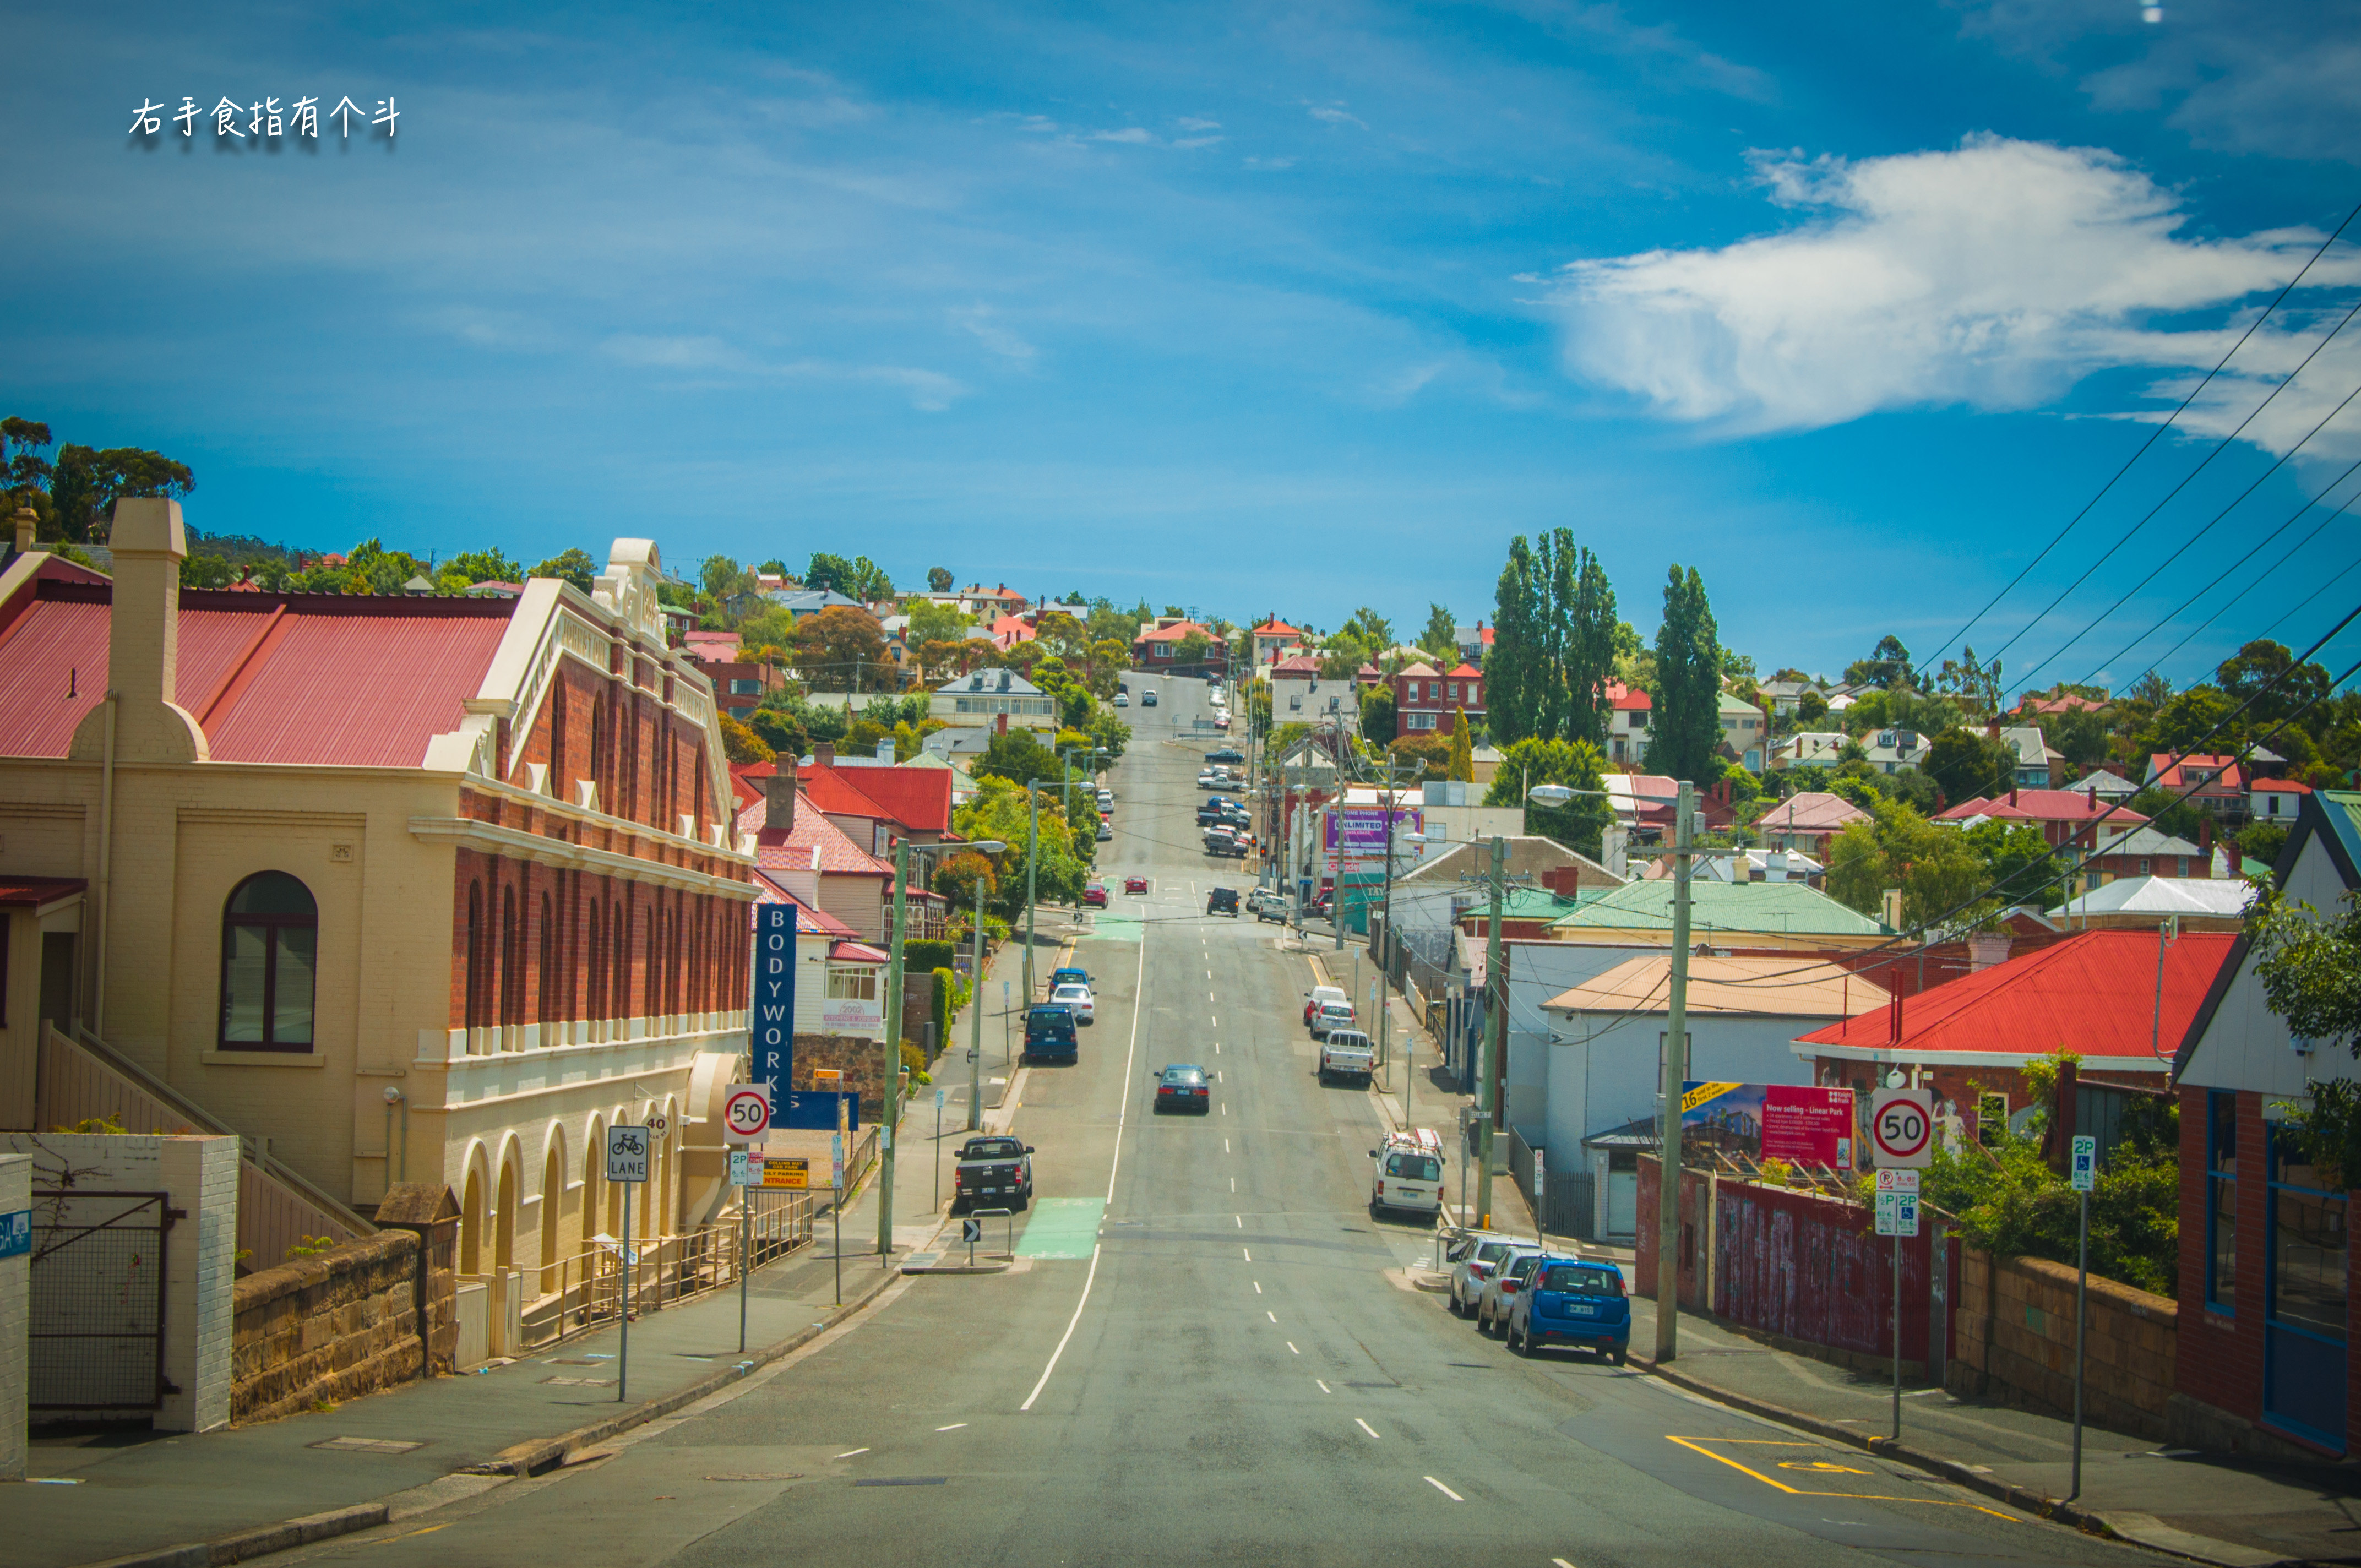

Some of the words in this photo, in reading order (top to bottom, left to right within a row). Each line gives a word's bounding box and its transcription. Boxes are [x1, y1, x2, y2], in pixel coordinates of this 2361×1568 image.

[842, 1005, 862, 1014] 2002
[1696, 1087, 1706, 1096] sold
[1712, 1087, 1725, 1096] weeks
[1682, 1092, 1697, 1109] 16
[733, 1103, 761, 1123] 50
[1783, 1105, 1804, 1115] selling
[646, 1118, 665, 1129] 40
[1884, 1115, 1921, 1140] 50
[2075, 1140, 2093, 1154] 2P
[733, 1155, 747, 1164] 2P
[612, 1162, 644, 1174] LANE
[1899, 1195, 1917, 1206] 2P
